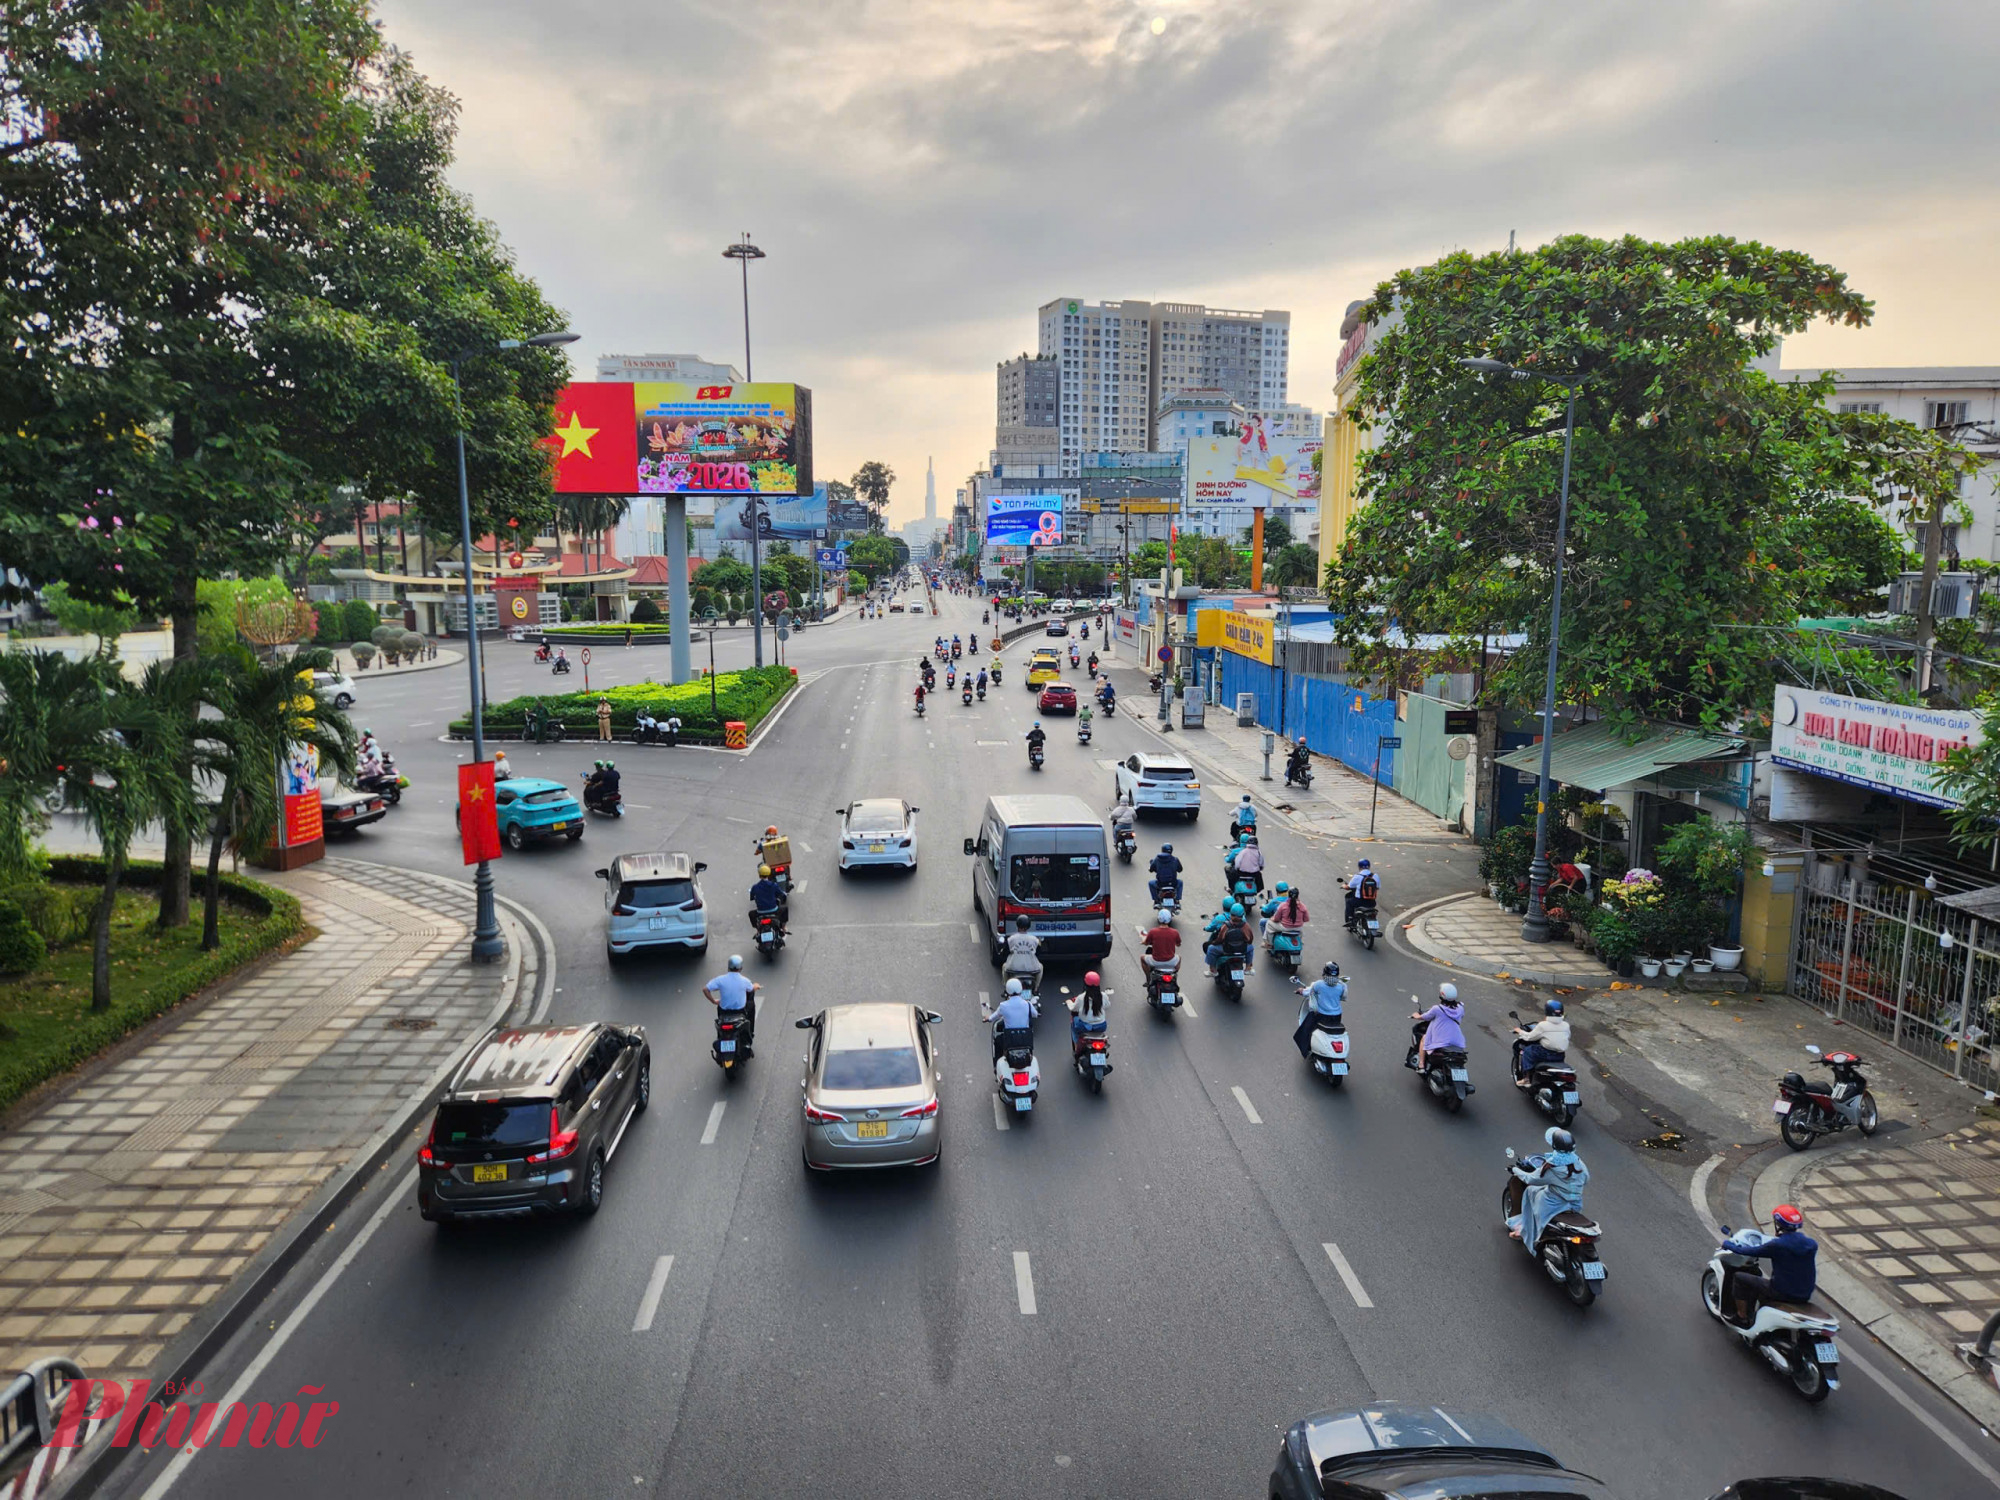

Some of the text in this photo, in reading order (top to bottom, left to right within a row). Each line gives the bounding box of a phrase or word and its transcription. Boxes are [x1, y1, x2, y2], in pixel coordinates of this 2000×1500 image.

[687, 462, 751, 490] 2026
[1217, 480, 1247, 489] DƯỠNG
[1819, 696, 1840, 707] CÔNG
[1843, 700, 1852, 709] TY
[1854, 702, 1875, 713] TNHH
[1876, 706, 1888, 716] TM
[1902, 710, 1913, 720] DV
[1804, 712, 1835, 741] HOA
[1838, 718, 1872, 748] LAN
[1778, 746, 1791, 756] HOA
[1793, 750, 1807, 760] LAN
[1813, 754, 1826, 765] CÂY
[1820, 742, 1836, 753] KINH
[1838, 746, 1862, 759] DOANH
[1871, 754, 1886, 765] MUA
